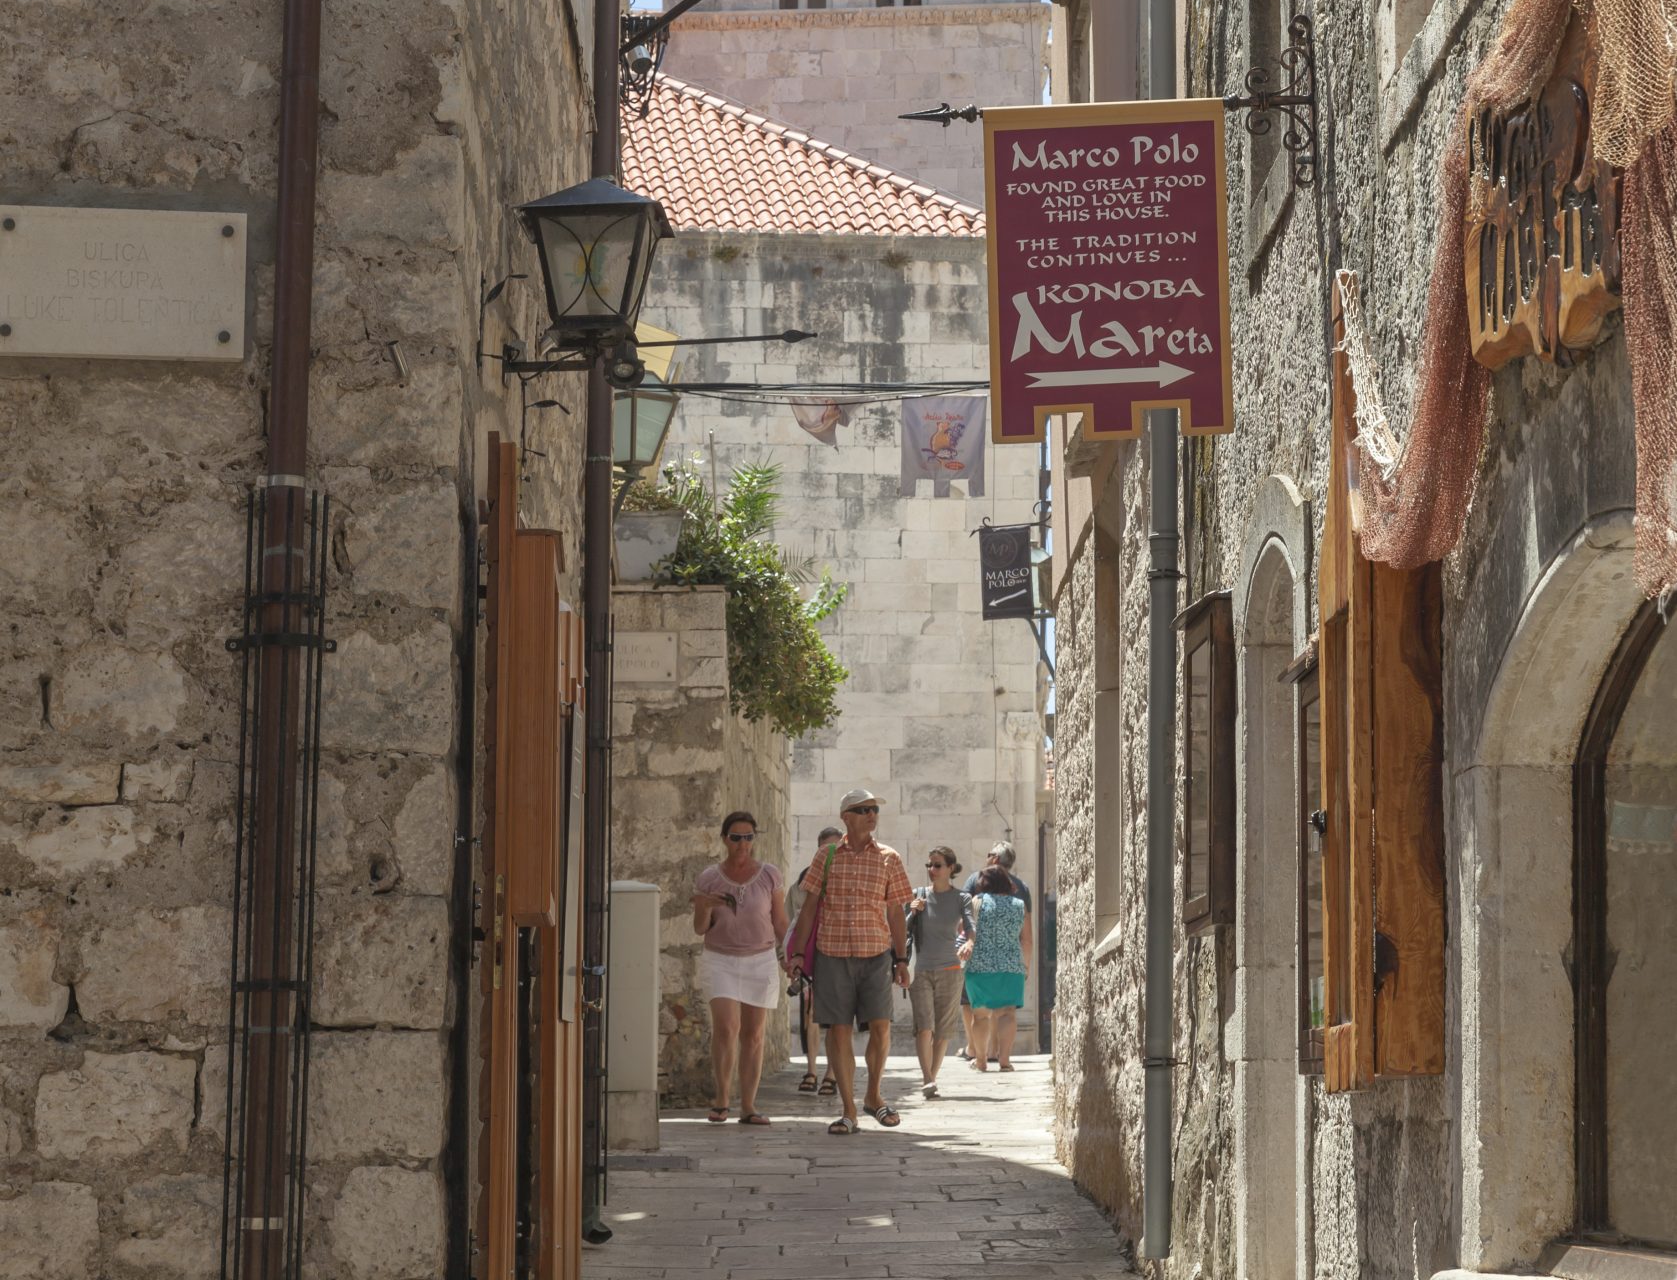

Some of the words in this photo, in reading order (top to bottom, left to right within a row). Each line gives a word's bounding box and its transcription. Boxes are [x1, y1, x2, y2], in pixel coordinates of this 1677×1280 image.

[1011, 139, 1121, 172] Marco
[1129, 133, 1200, 167] Polo
[1006, 181, 1077, 196] FOUND
[1082, 177, 1150, 193] GREAT
[1154, 174, 1207, 189] FOOD
[1041, 194, 1086, 209] AND
[1091, 191, 1145, 206] LOVE
[1149, 191, 1172, 204] IN
[1044, 208, 1091, 223] THIS
[1095, 205, 1170, 221] HOUSE.
[83, 241, 150, 262] ULICA
[1015, 237, 1060, 253] THE
[1072, 231, 1198, 249] TRADITION
[1026, 249, 1162, 269] CONTINUES
[66, 268, 165, 290] BISKUPA
[1036, 278, 1206, 305] KONOBA
[6, 294, 74, 322] LUKE
[1010, 291, 1214, 363] Mareta
[986, 567, 1030, 580] MARCO
[989, 578, 1016, 590] POLO
